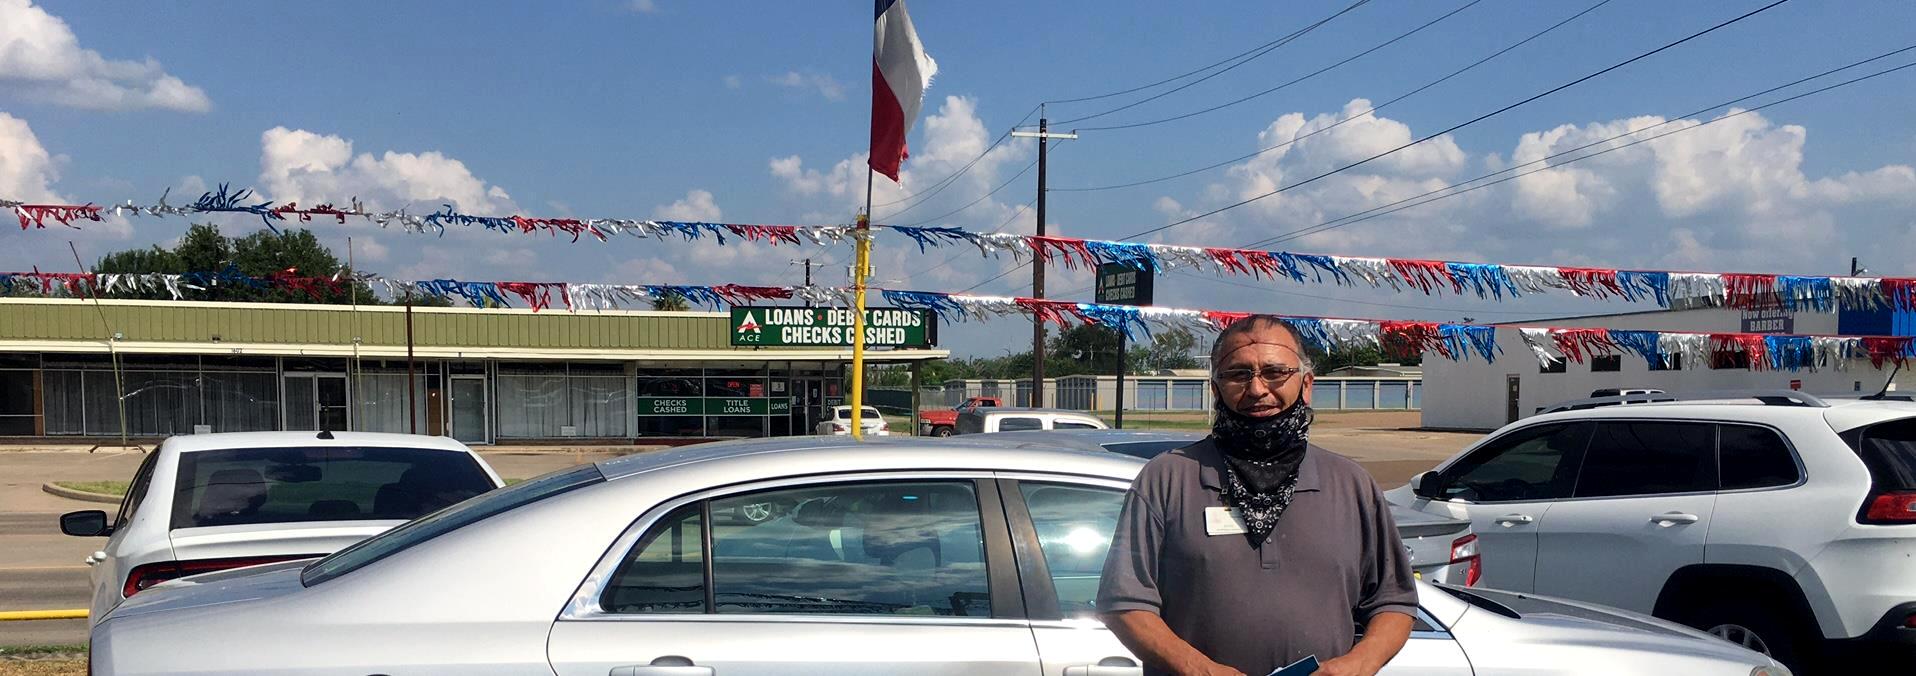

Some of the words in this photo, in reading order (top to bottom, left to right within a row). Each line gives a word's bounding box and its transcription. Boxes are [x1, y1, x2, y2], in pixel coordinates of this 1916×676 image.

[765, 309, 814, 326] LOANS
[827, 309, 869, 326] DEBT
[872, 310, 921, 327] CARDS
[1750, 320, 1784, 331] BARBER
[781, 326, 843, 344] CHECKS
[846, 327, 905, 344] CSHED
[771, 402, 788, 410] LOANS
